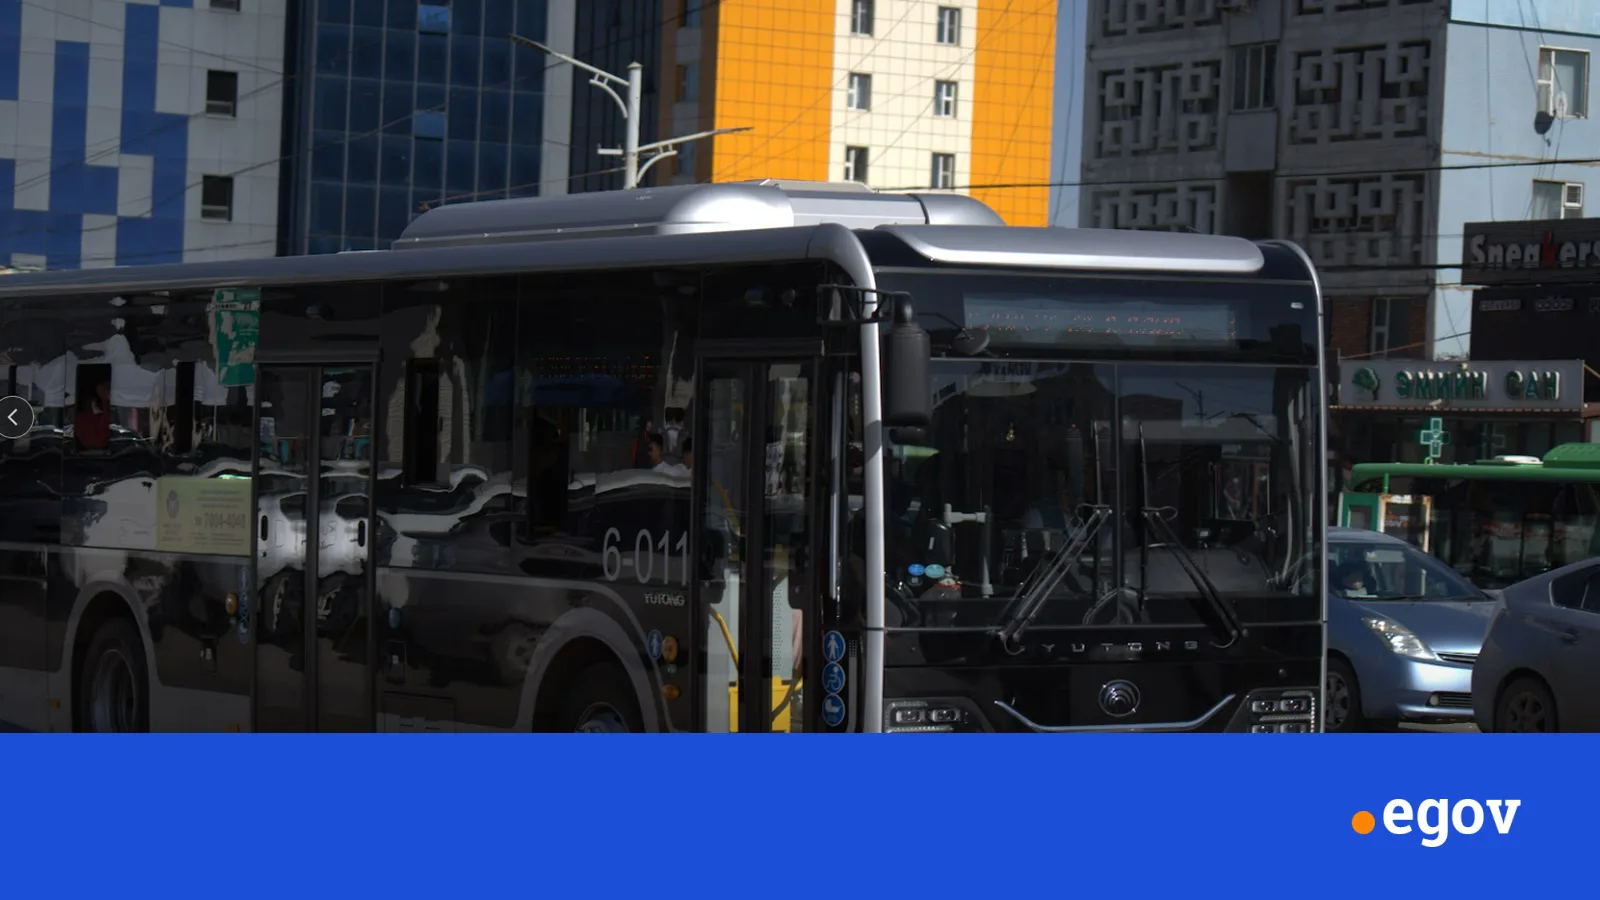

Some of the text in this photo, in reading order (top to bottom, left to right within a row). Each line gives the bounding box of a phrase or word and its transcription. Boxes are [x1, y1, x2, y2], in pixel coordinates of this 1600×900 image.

[1506, 370, 1560, 400] САН
[602, 526, 688, 586] 6-011
[644, 593, 686, 606] YUTONG
